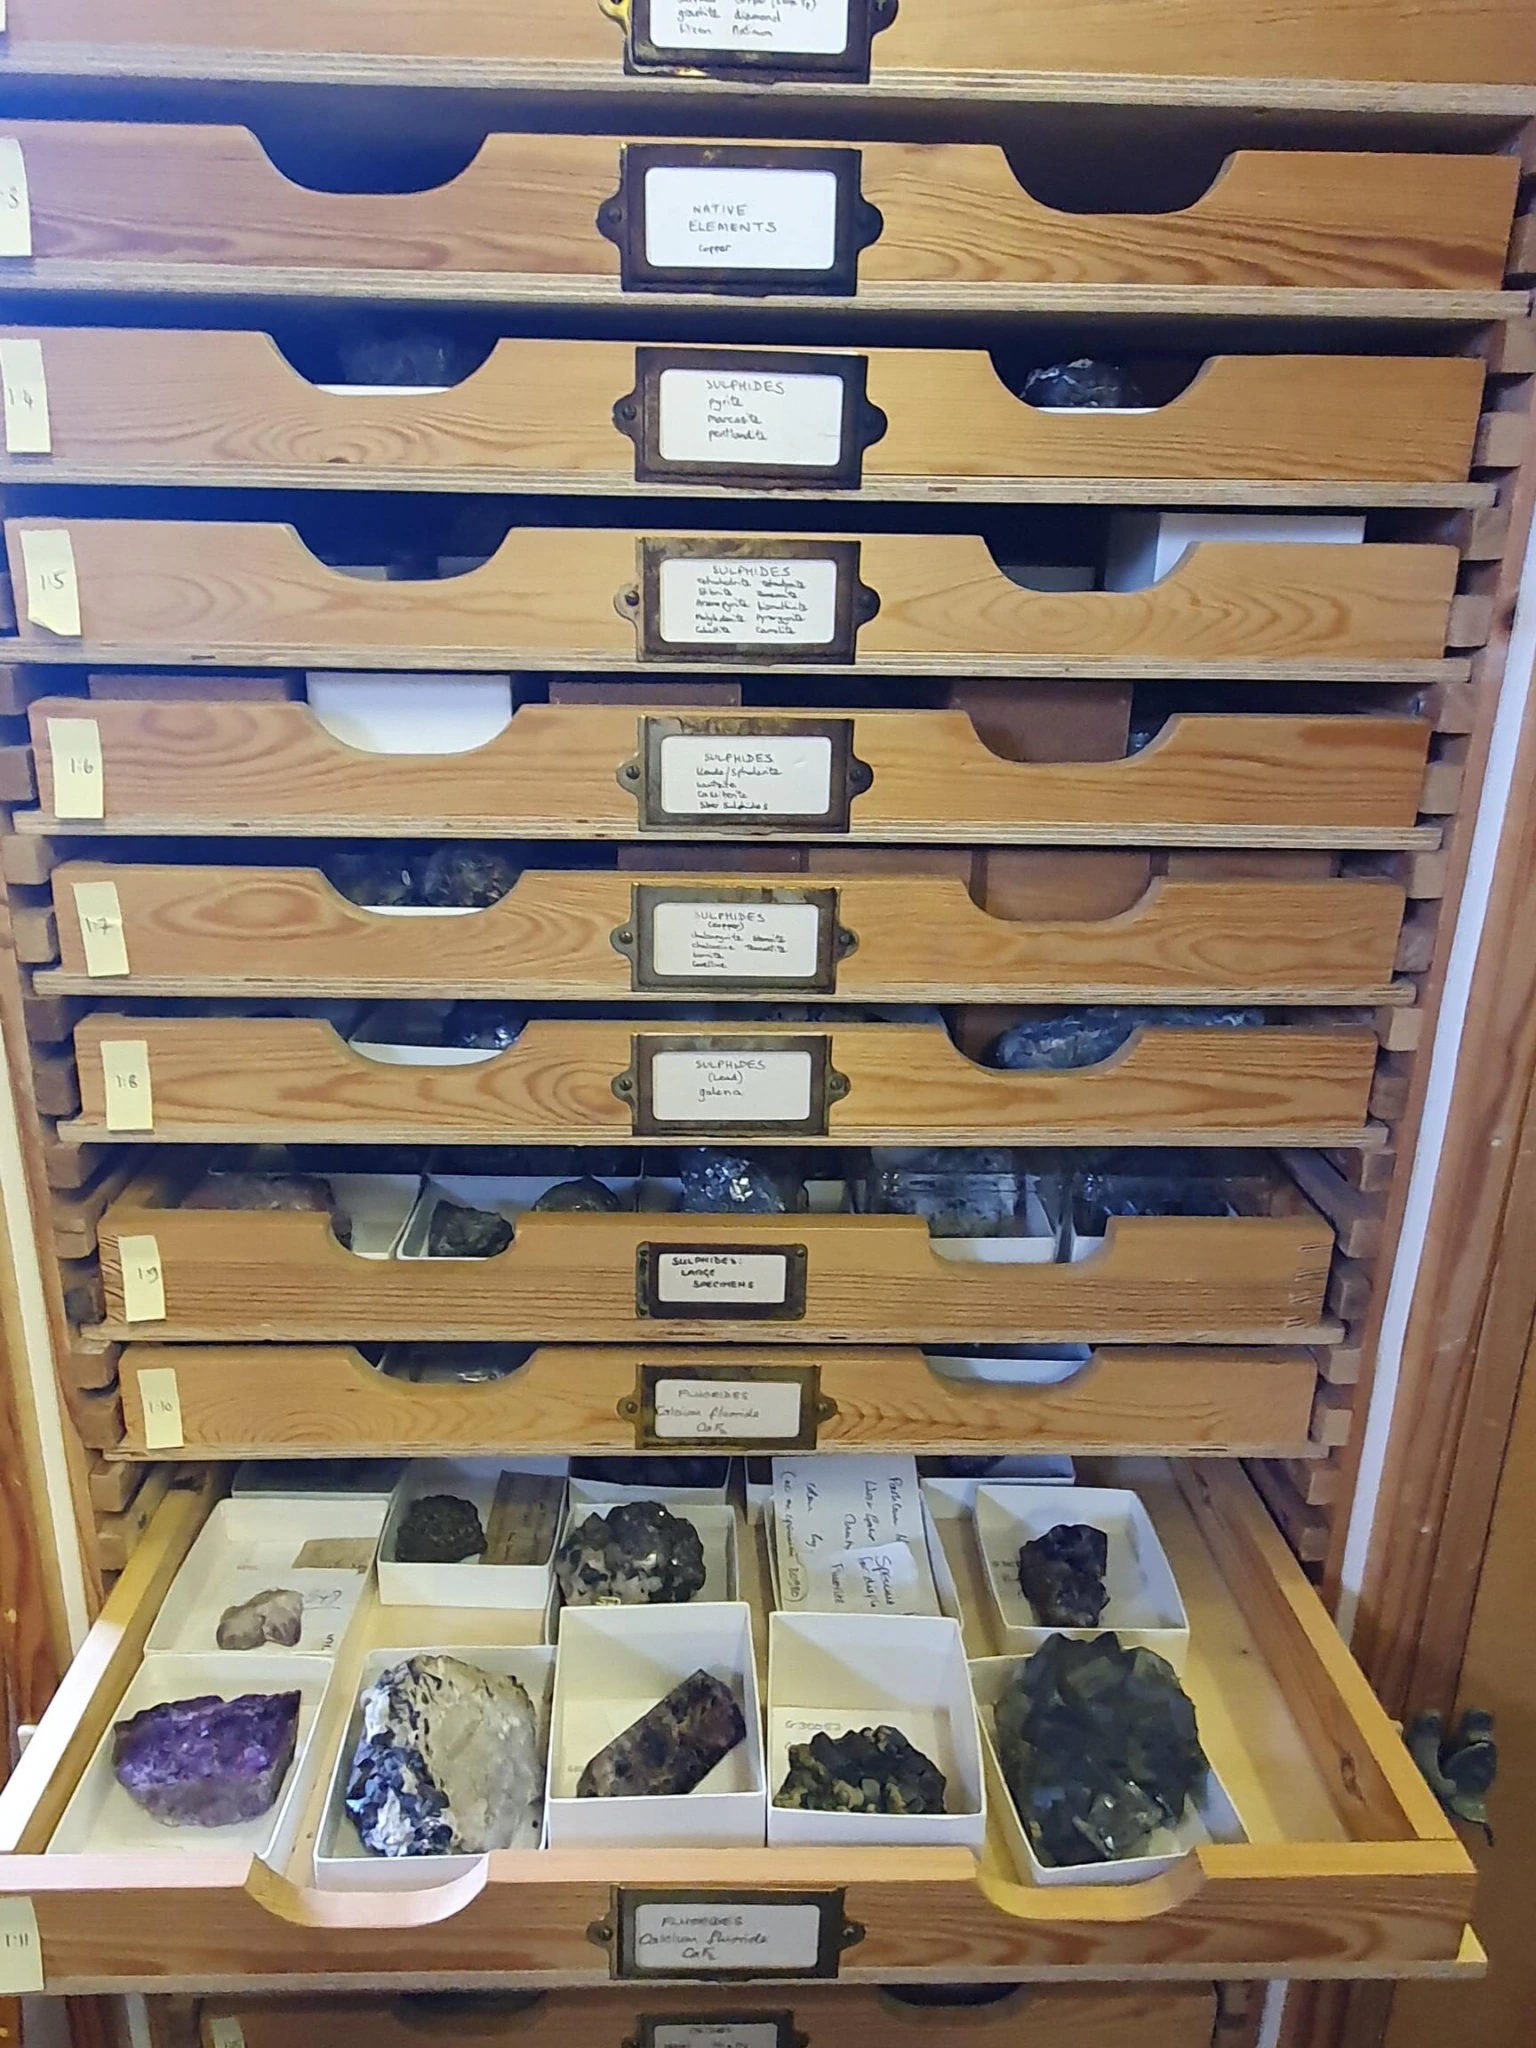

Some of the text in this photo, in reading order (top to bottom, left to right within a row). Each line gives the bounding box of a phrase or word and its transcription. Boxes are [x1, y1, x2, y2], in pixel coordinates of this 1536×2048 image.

[693, 204, 747, 216] NATIVE
[688, 221, 777, 233] ELEMENTS
[706, 380, 785, 394] SULPHIDES
[709, 395, 743, 411] pyrite
[707, 413, 762, 425] marcasite
[713, 565, 792, 577] SULPHIDES
[704, 753, 774, 763] SULPHIDES
[694, 912, 766, 923] SULPHIDES
[696, 1060, 766, 1070] SULPHIDES
[698, 1087, 743, 1102] galena
[681, 1268, 715, 1277] LARGE
[692, 1281, 754, 1289] SPECIMENS
[678, 1389, 748, 1400] FLUORIDES
[656, 1405, 759, 1420] Calcium fluoride
[661, 1916, 743, 1927] FLUORIDES
[639, 1929, 768, 1946] Calcium fluoride
